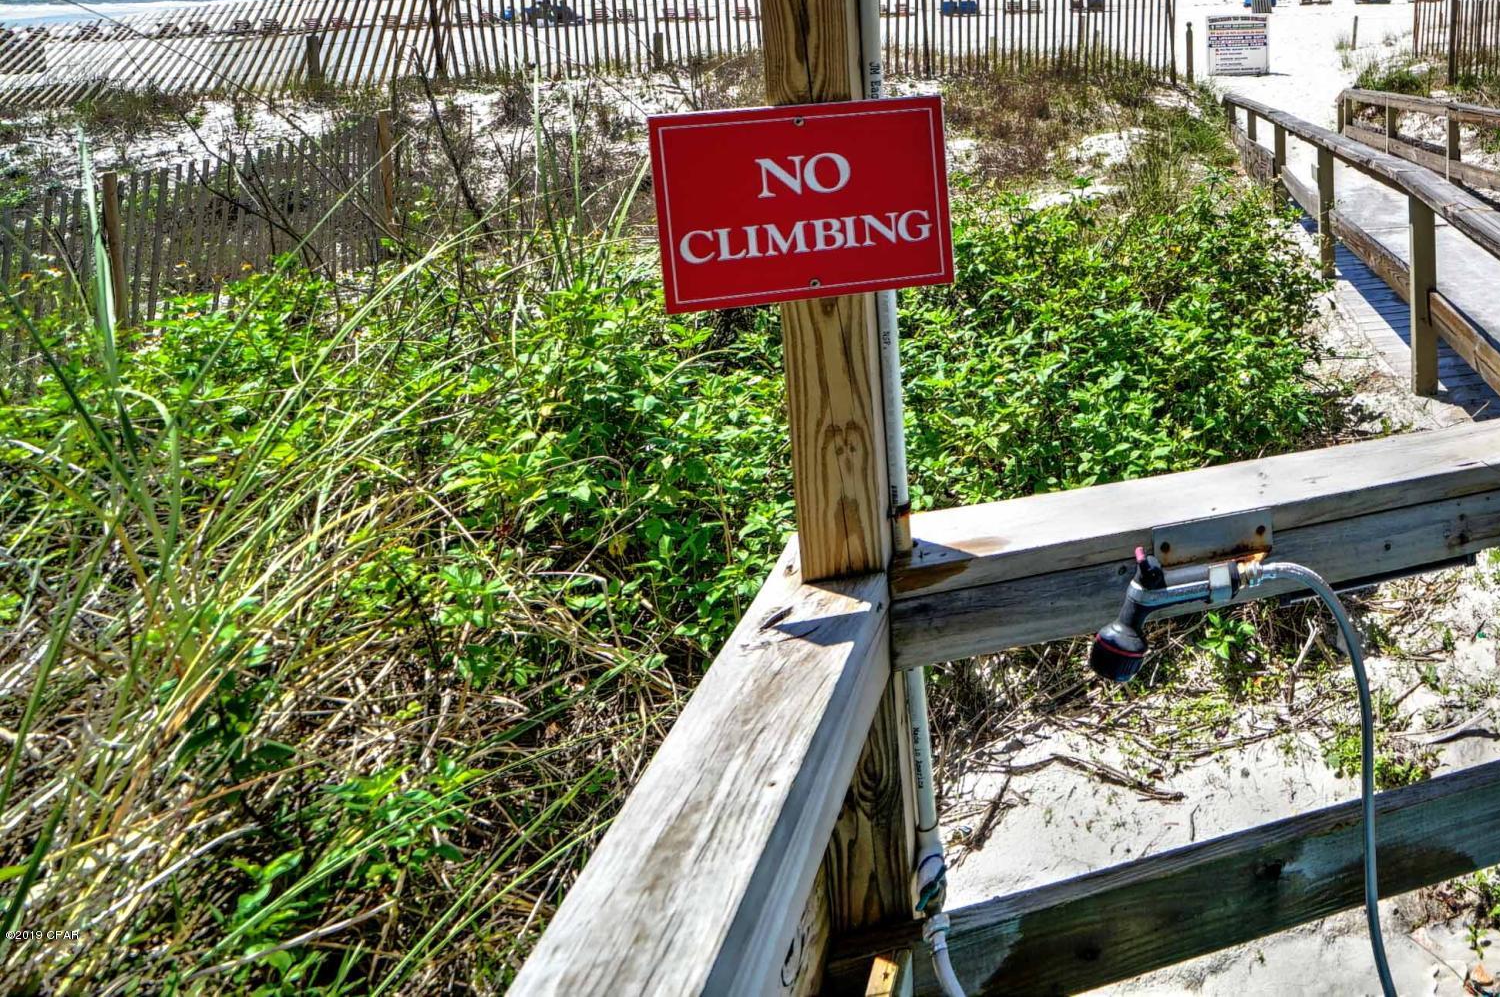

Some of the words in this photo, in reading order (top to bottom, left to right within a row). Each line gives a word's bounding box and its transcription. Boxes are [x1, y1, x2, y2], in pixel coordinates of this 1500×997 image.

[869, 62, 881, 75] JM
[754, 152, 851, 200] NO
[679, 209, 933, 265] CLIMBING
